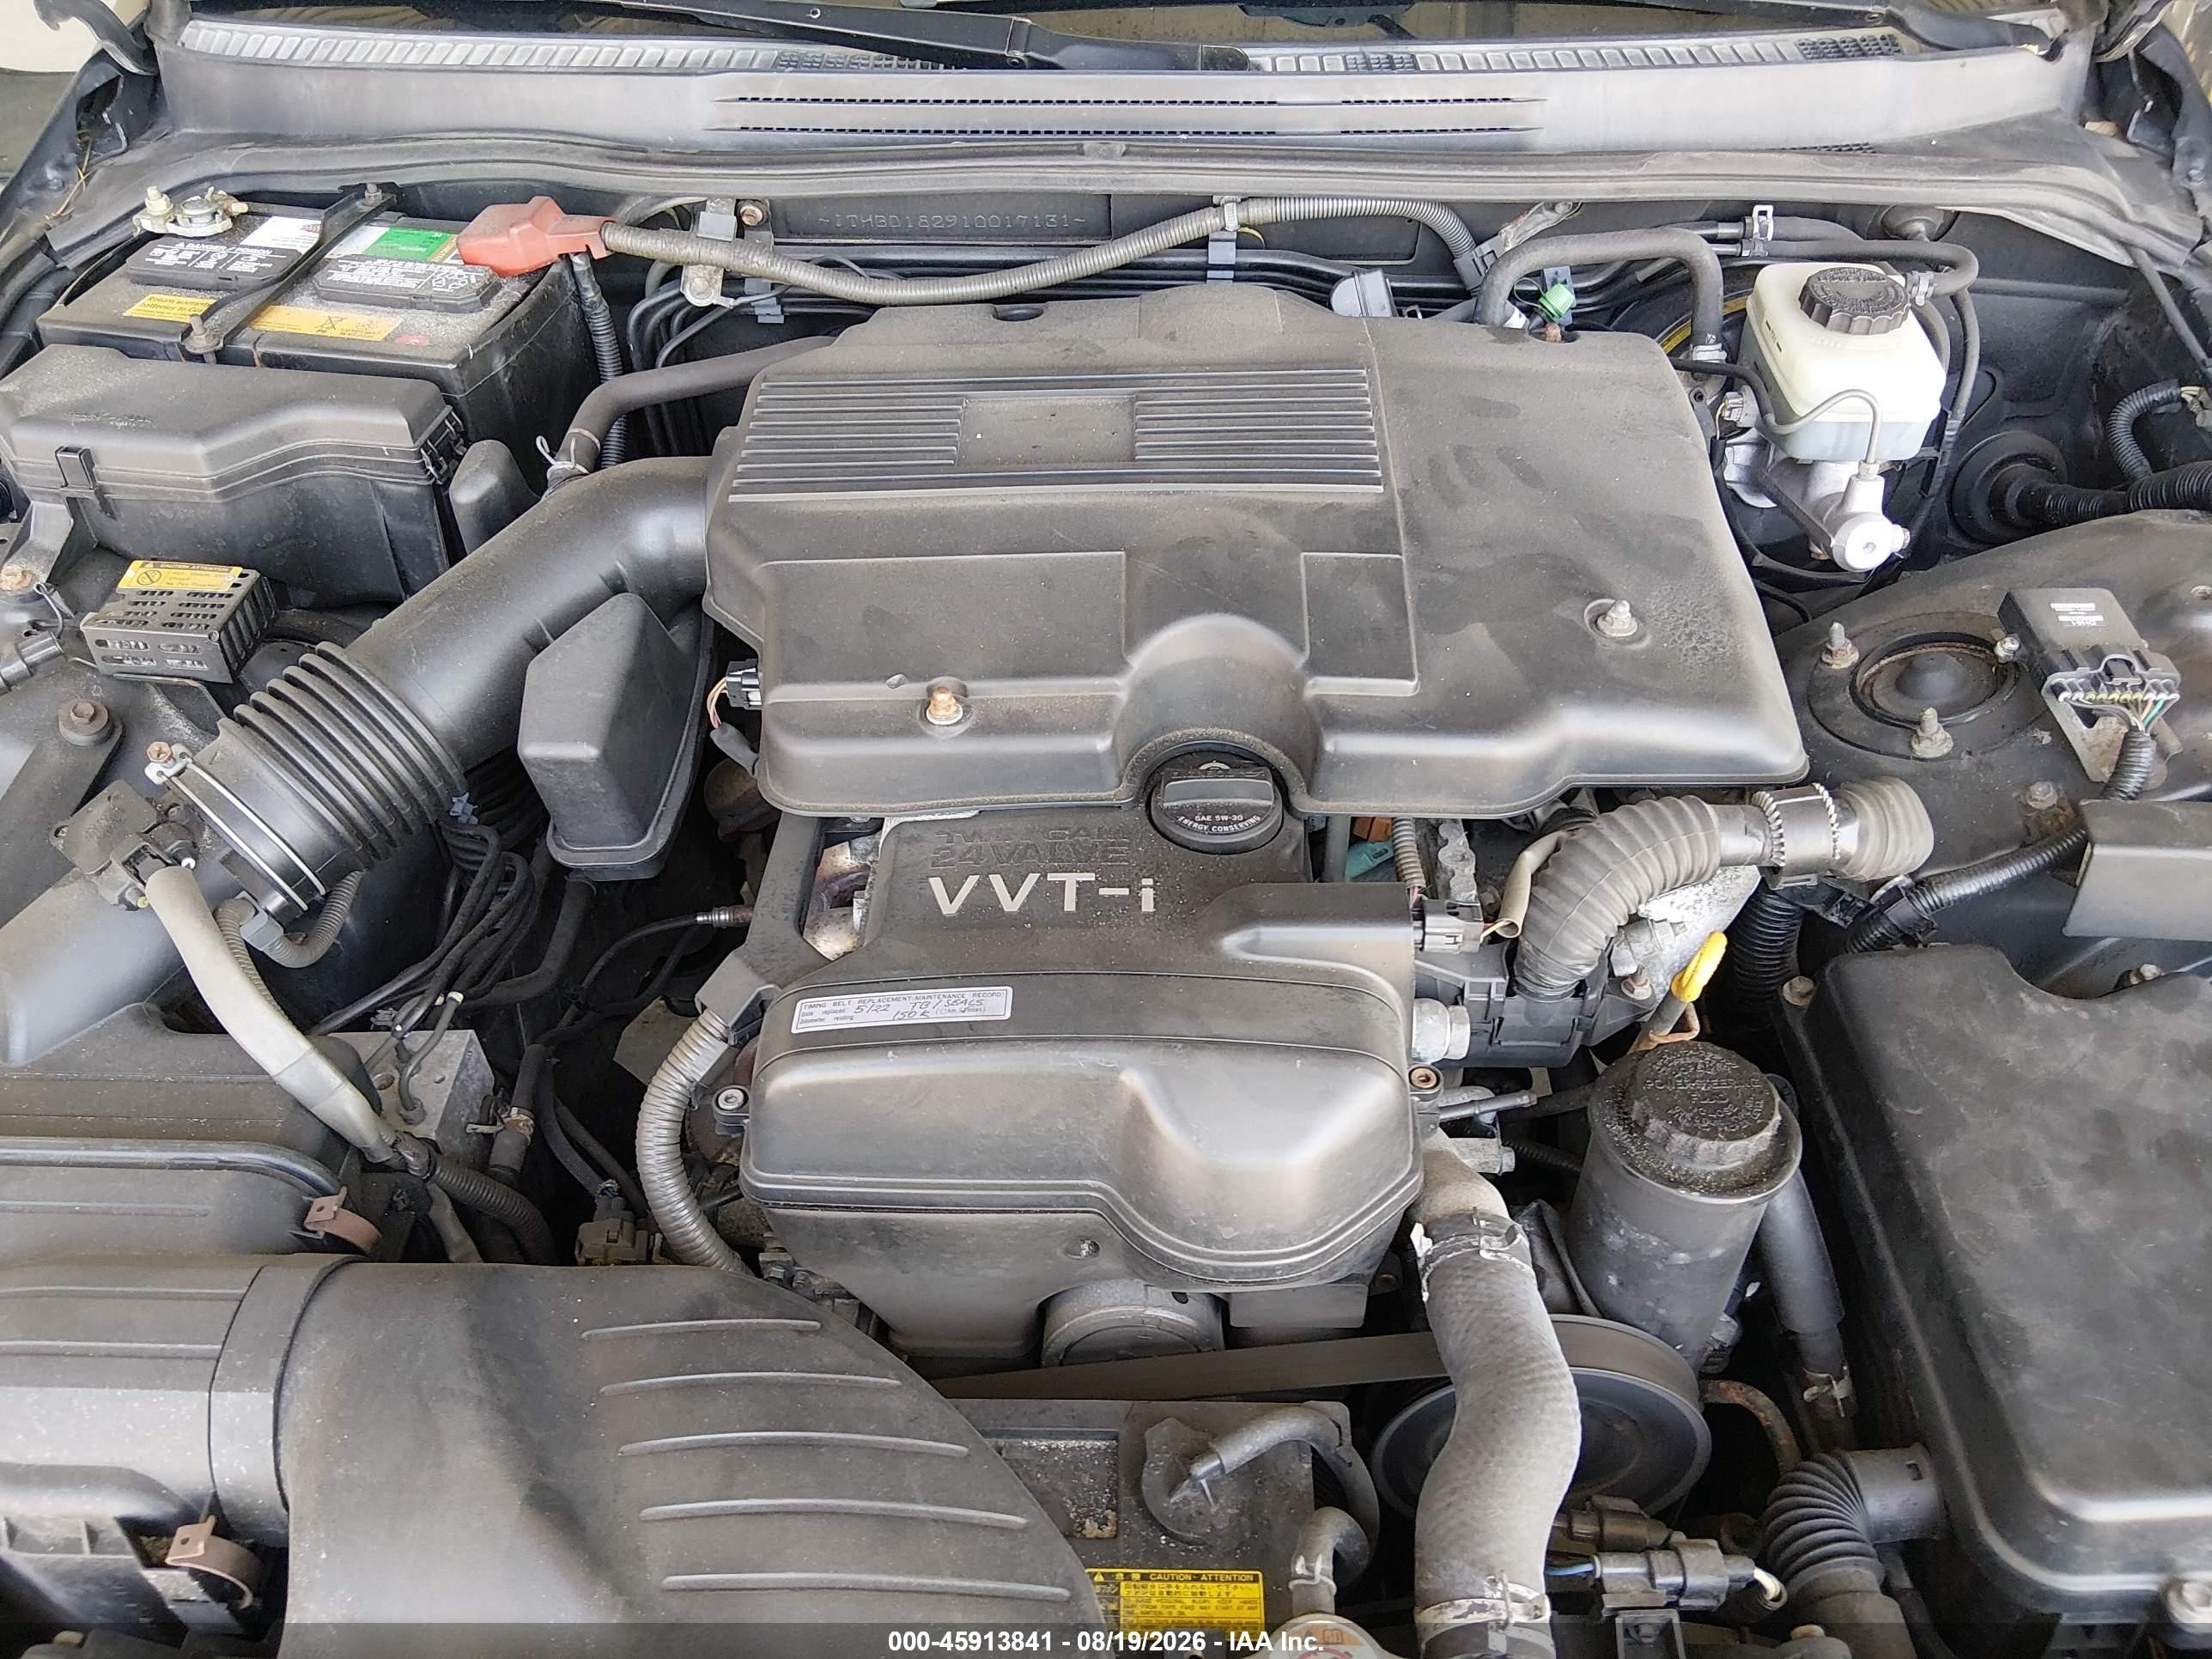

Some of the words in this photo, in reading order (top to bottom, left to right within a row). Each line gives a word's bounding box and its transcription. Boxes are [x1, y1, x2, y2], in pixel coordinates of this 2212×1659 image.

[1211, 815, 1261, 832] CONSERVING
[927, 872, 1155, 915] VVT-i
[857, 995, 911, 1005] REPLACEMENT
[854, 1003, 890, 1013] 5/22
[1200, 1573, 1254, 1582] ATTENTION
